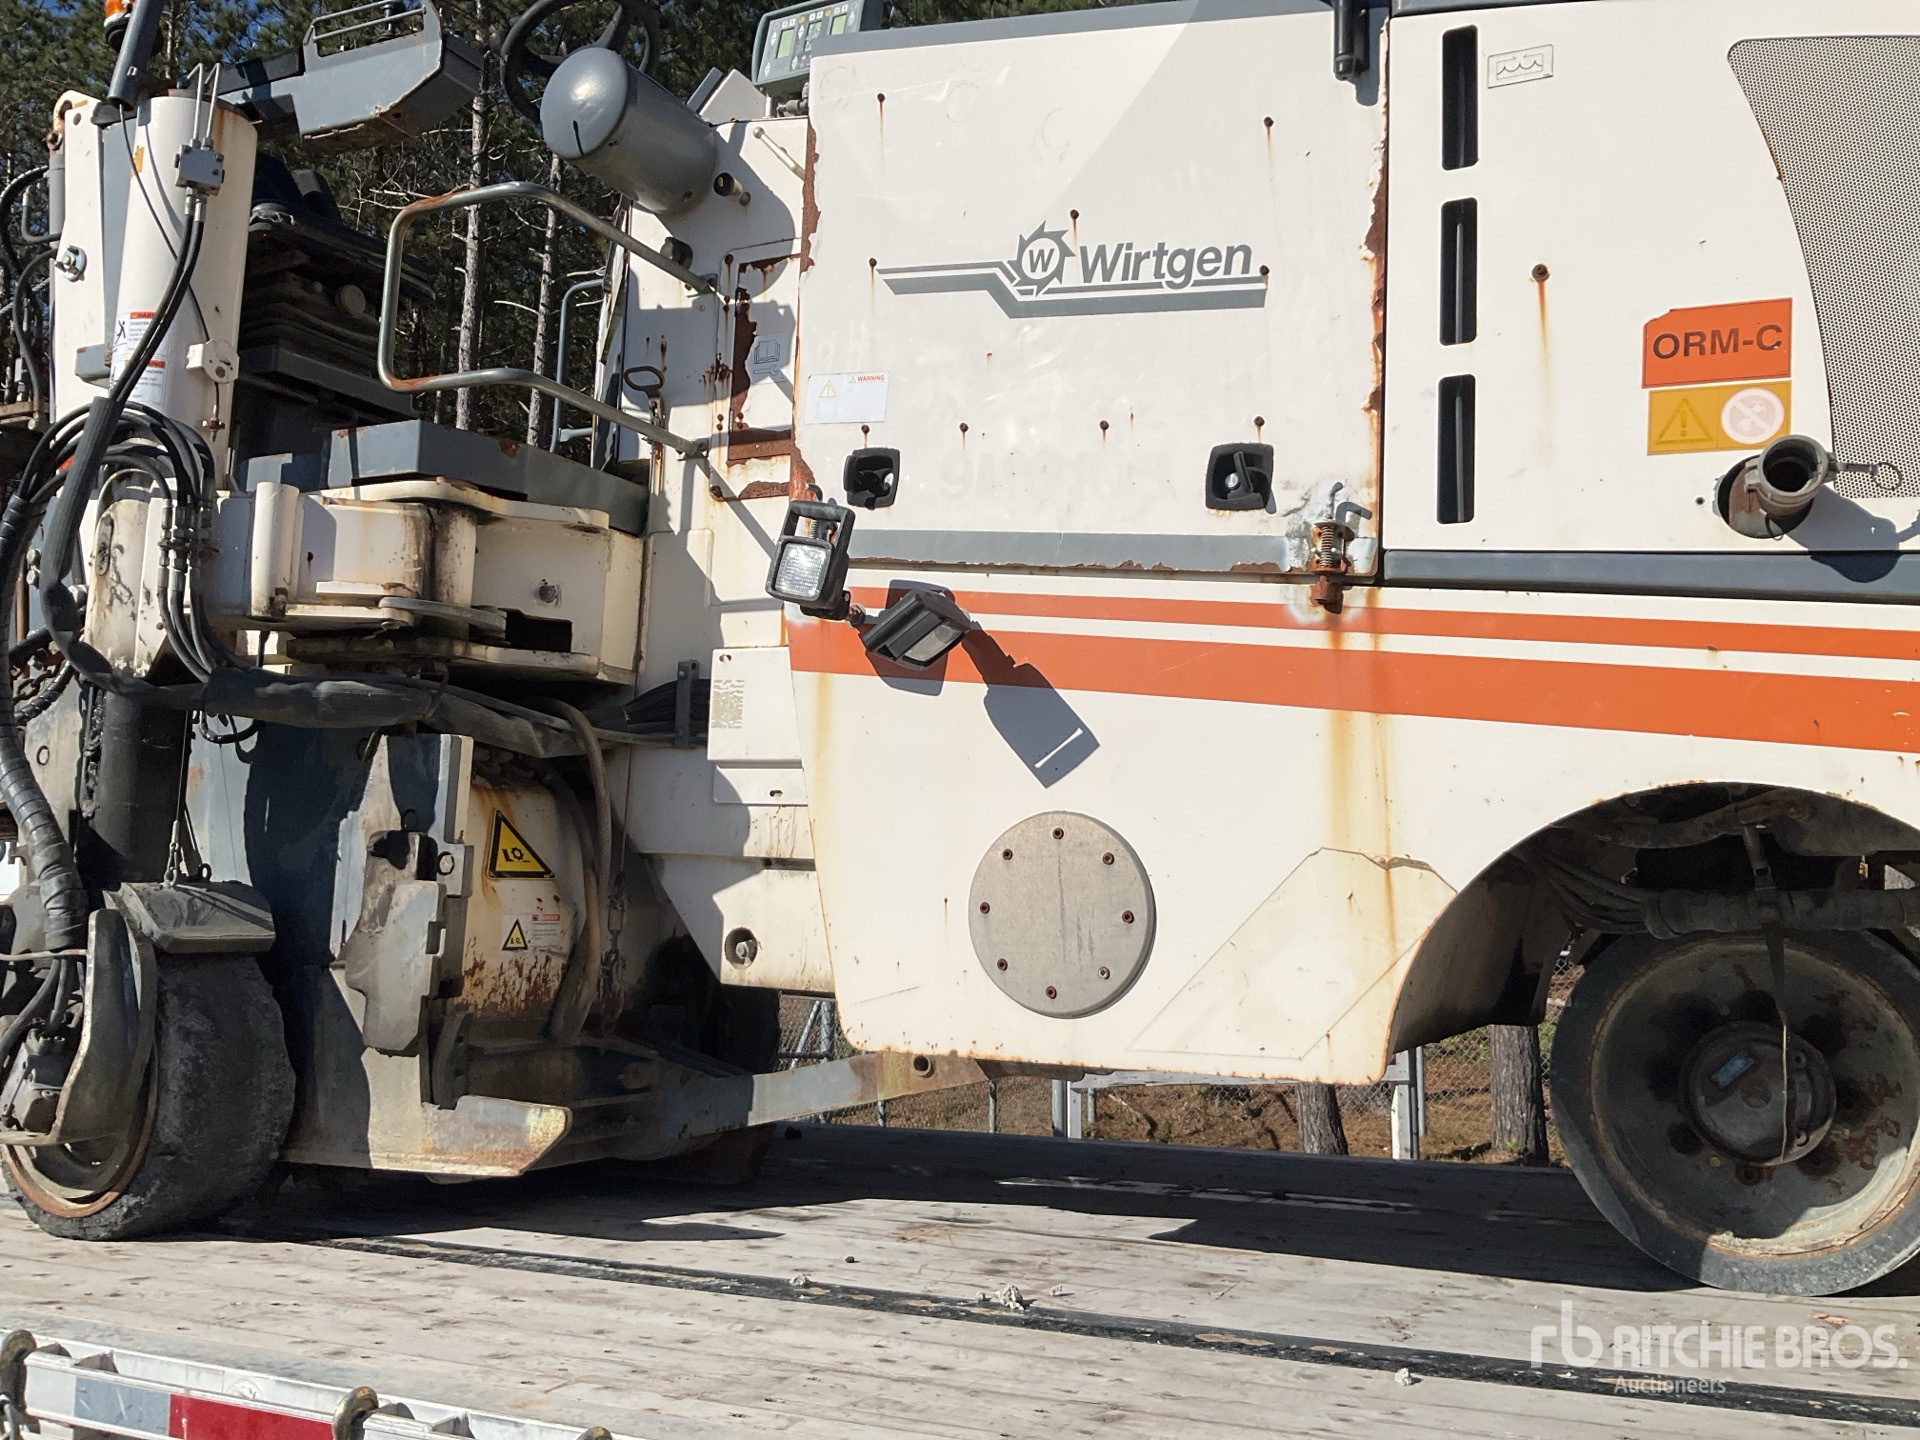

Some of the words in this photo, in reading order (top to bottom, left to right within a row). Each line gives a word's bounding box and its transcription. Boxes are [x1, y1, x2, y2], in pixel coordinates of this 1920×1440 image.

[1028, 249, 1055, 273] W
[1080, 242, 1253, 290] Wirtgen
[1653, 324, 1783, 360] ORM-C
[857, 374, 886, 382] WARNING
